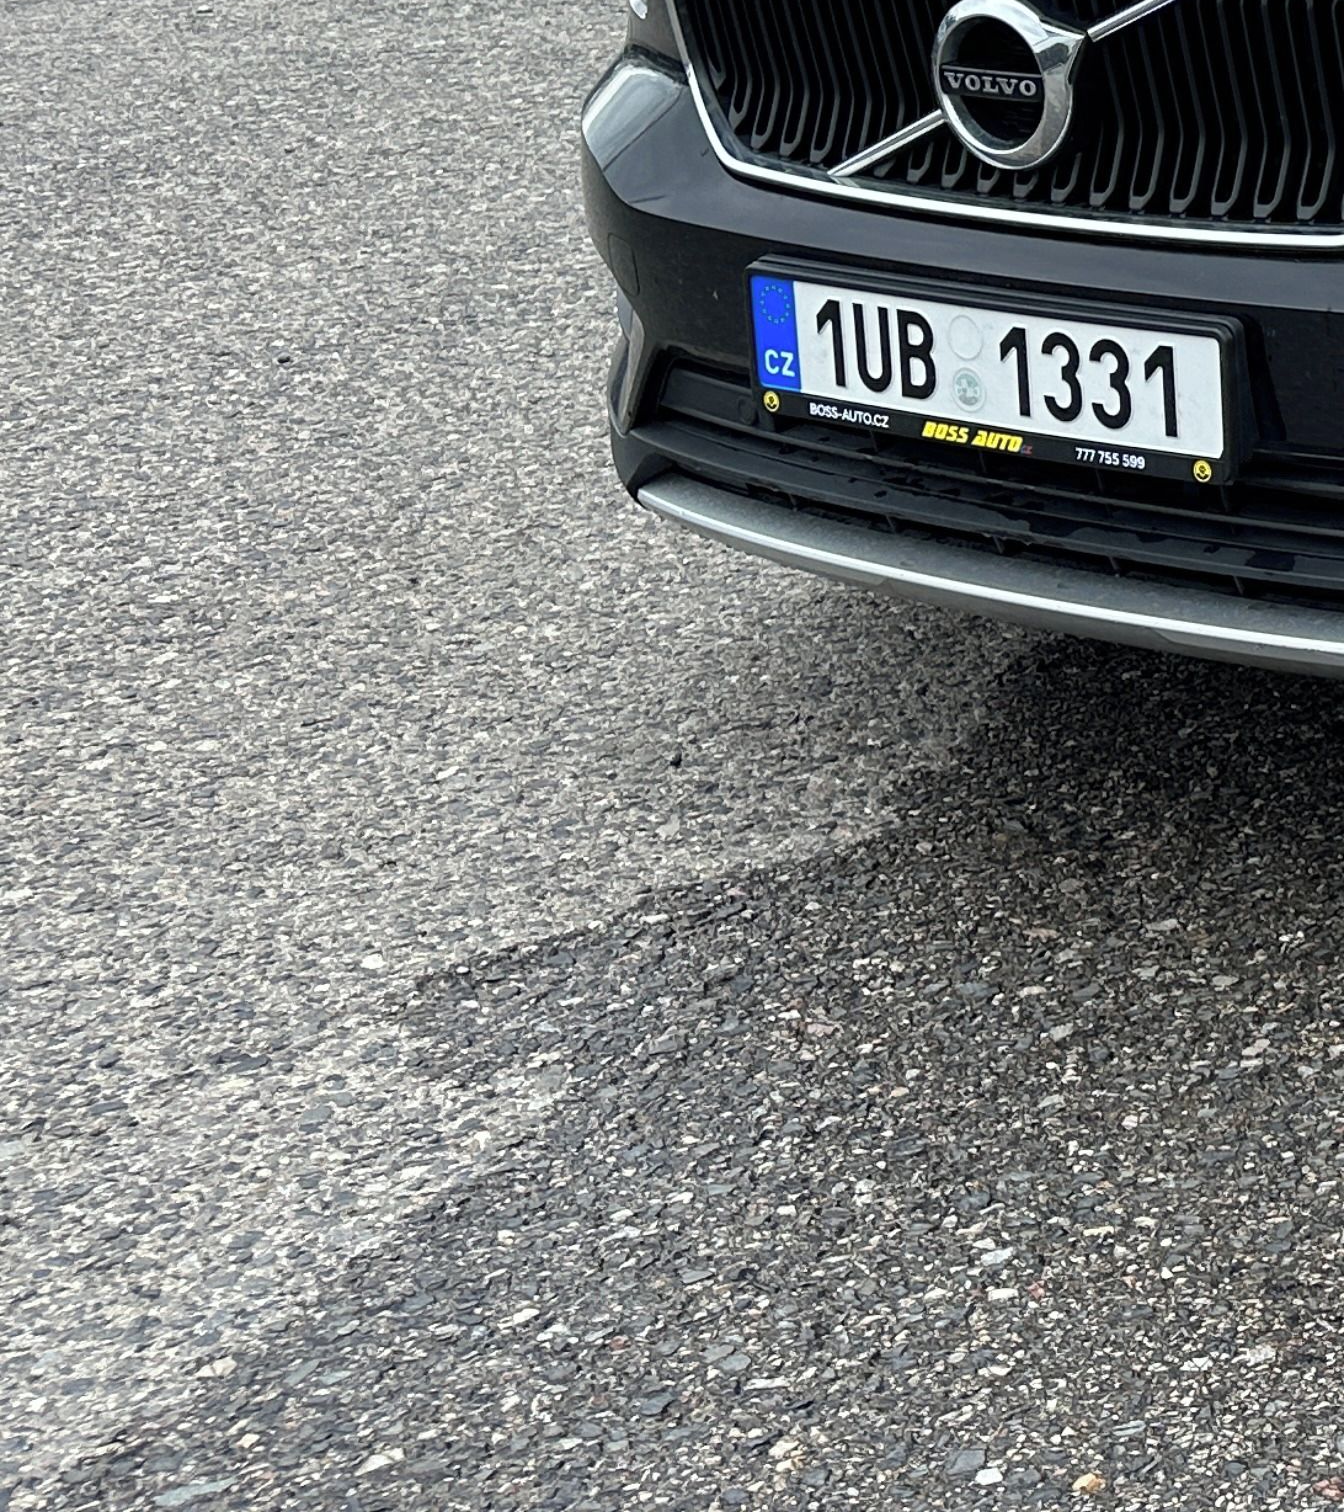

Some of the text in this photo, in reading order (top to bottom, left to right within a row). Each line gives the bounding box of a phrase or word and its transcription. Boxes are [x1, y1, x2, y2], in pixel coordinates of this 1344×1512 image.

[943, 71, 1038, 96] VOLVO
[764, 349, 796, 378] CZ
[816, 298, 1180, 438] 1UB 1331
[809, 402, 890, 429] BOSS-AUTO.CZ
[921, 421, 969, 444] BOSS
[971, 429, 1024, 453] AUTO
[1075, 446, 1146, 470] 777 755 599
